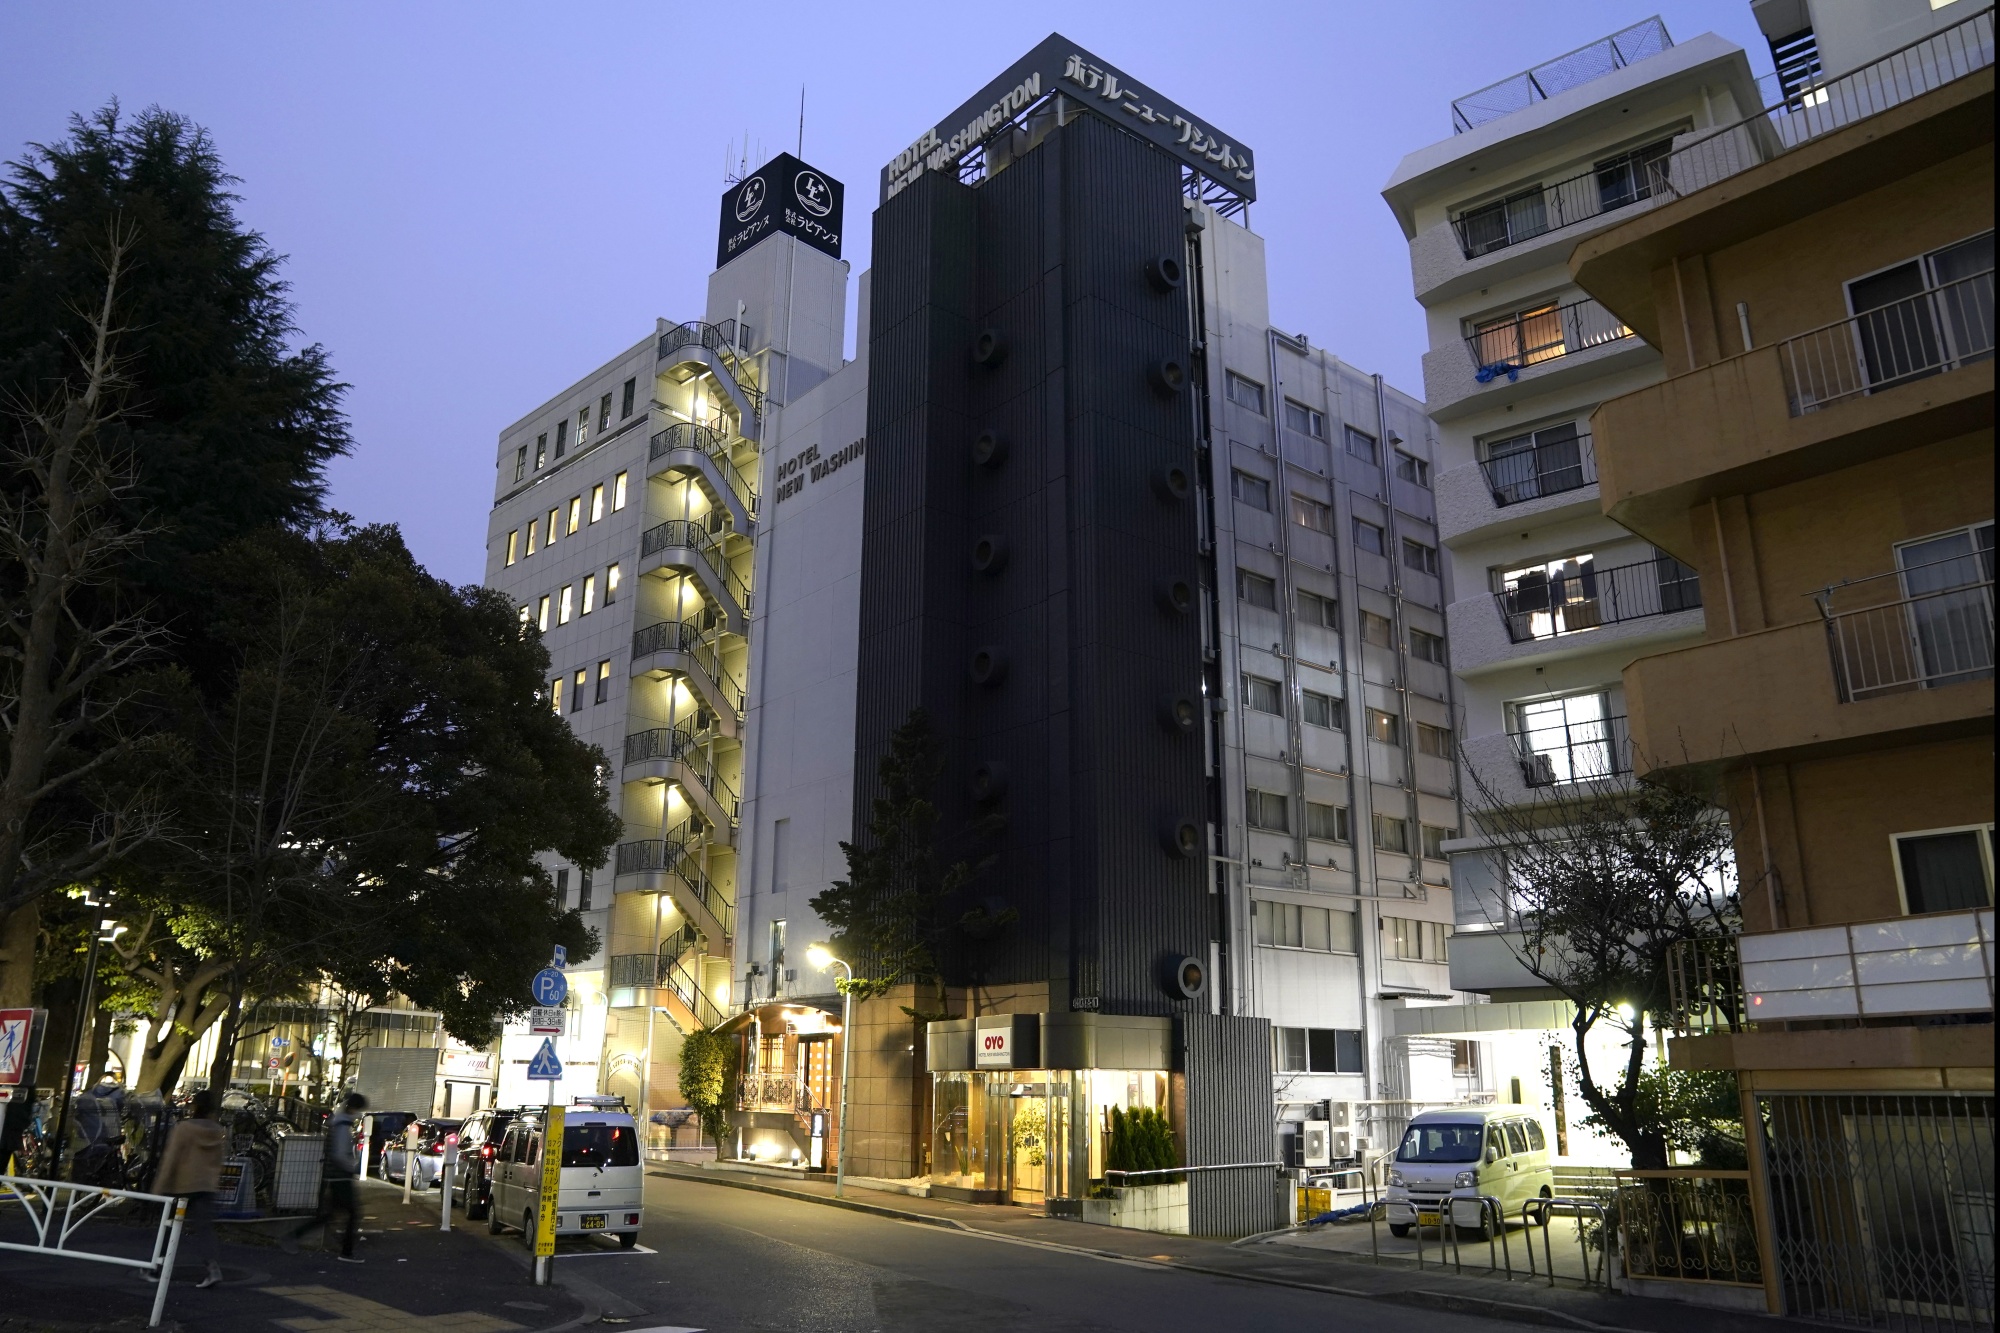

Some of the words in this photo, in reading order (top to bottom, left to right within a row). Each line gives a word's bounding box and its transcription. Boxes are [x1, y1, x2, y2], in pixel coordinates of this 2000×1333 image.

[887, 161, 924, 200] NEW
[927, 71, 1041, 171] WASHINGTON
[1063, 53, 1254, 181] ホテルニューワシントン
[888, 127, 942, 183] HOTEL
[776, 473, 804, 504] NEW
[810, 437, 866, 484] WASHIN
[777, 443, 820, 482] HOTEL
[541, 977, 554, 1000] P
[984, 1035, 1004, 1050] OYO
